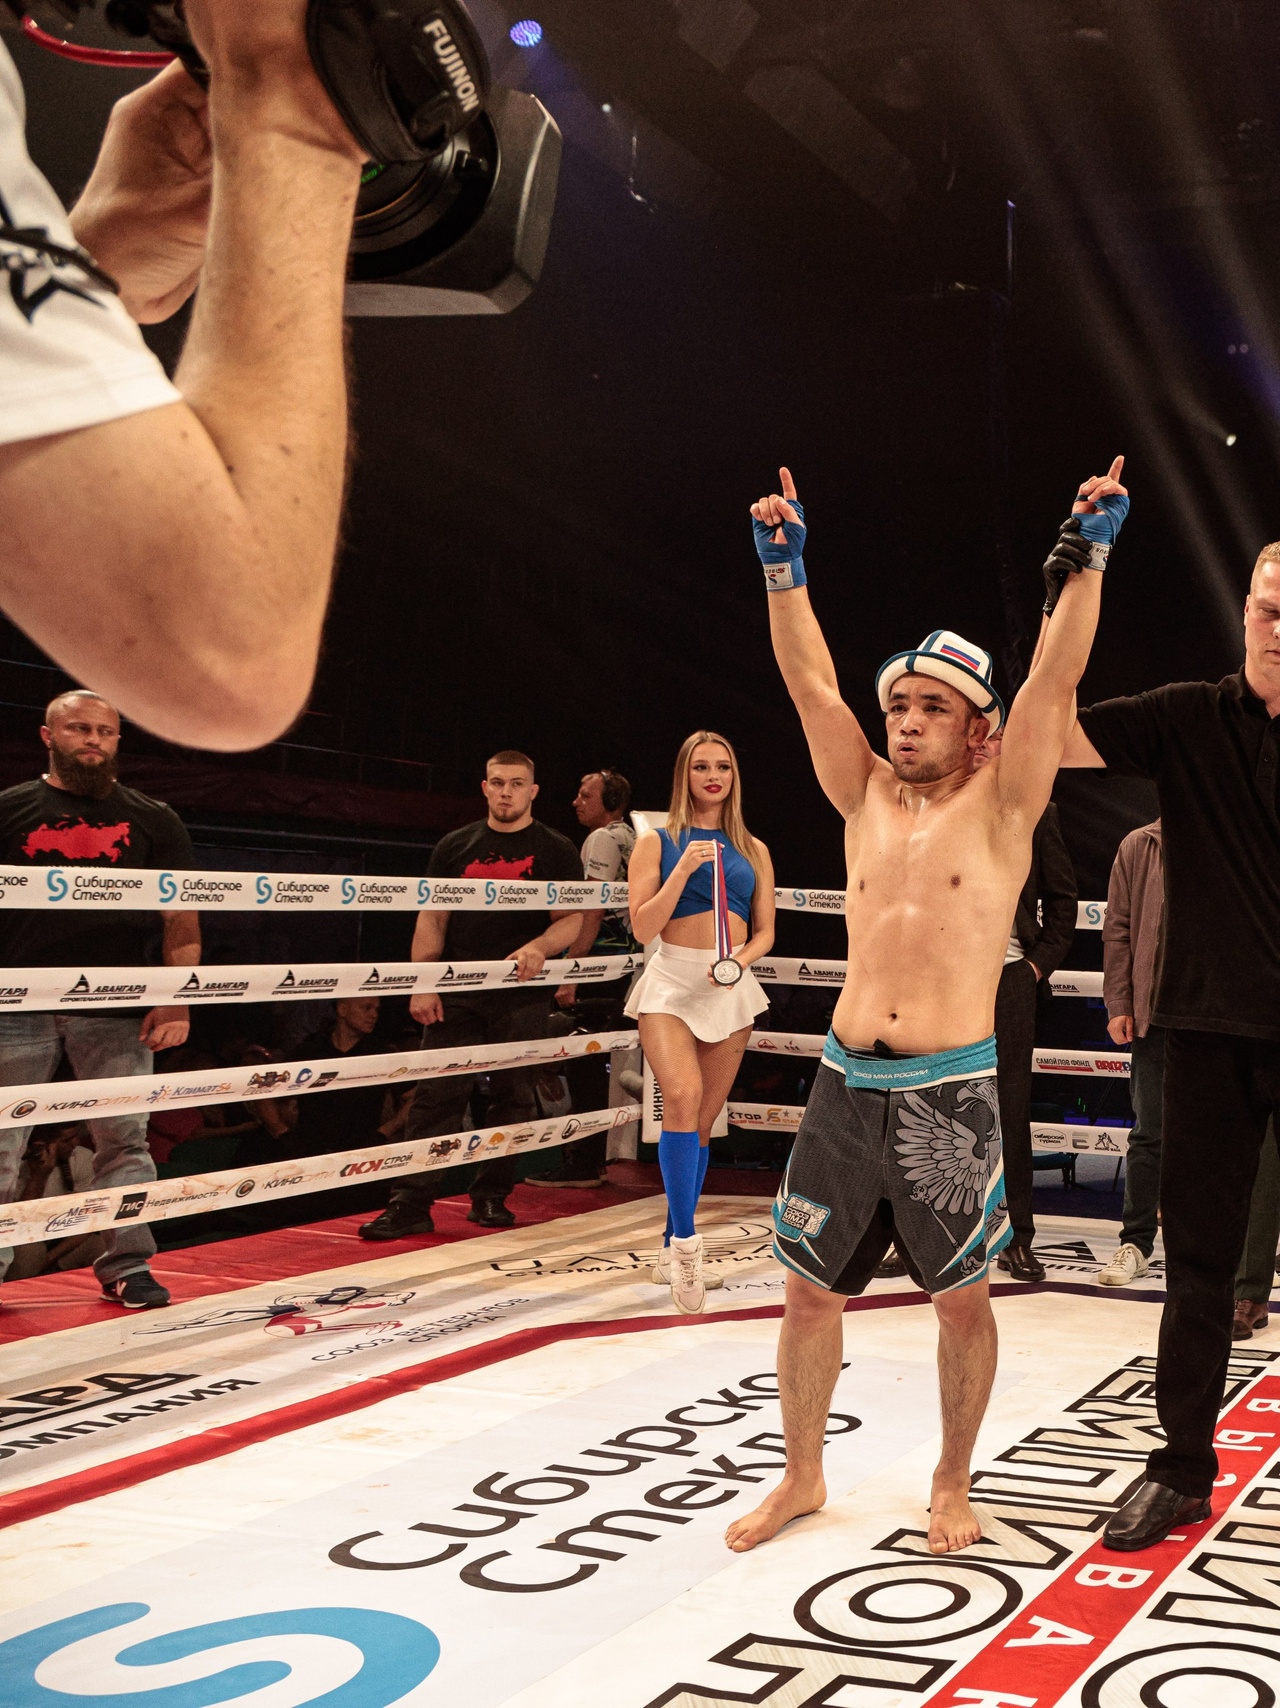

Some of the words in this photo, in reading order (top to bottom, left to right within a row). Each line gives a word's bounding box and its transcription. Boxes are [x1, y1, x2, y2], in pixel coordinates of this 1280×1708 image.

[423, 19, 480, 113] FUJINON
[74, 876, 143, 890] Сибирское
[182, 879, 242, 892] Сибирское
[276, 881, 330, 894] Сибирское
[360, 883, 407, 895] Сибирское
[72, 889, 122, 901] Стекло
[434, 884, 476, 896] Сибирское
[500, 886, 539, 896] Сибирское
[180, 891, 225, 903] Стекло
[274, 893, 314, 904] Стекло
[357, 894, 392, 904] Стекло
[431, 894, 463, 904] Стекло
[497, 895, 526, 904] Стекло
[808, 900, 842, 910] Стекло
[93, 985, 147, 994] АВАНГАРД
[894, 1069, 929, 1078] РОССИИ
[173, 1083, 232, 1097] Климат54
[384, 1152, 413, 1165] СТРОЙ
[120, 1200, 144, 1212] ГИС
[146, 1191, 219, 1208] Недвижимость
[784, 1212, 806, 1225] ММА
[311, 1338, 395, 1363] СОЮЗ
[395, 1297, 531, 1338] ВЕТЕРАНОВ
[407, 1315, 507, 1345] СПОРТА
[328, 1362, 851, 1572] Сибирско
